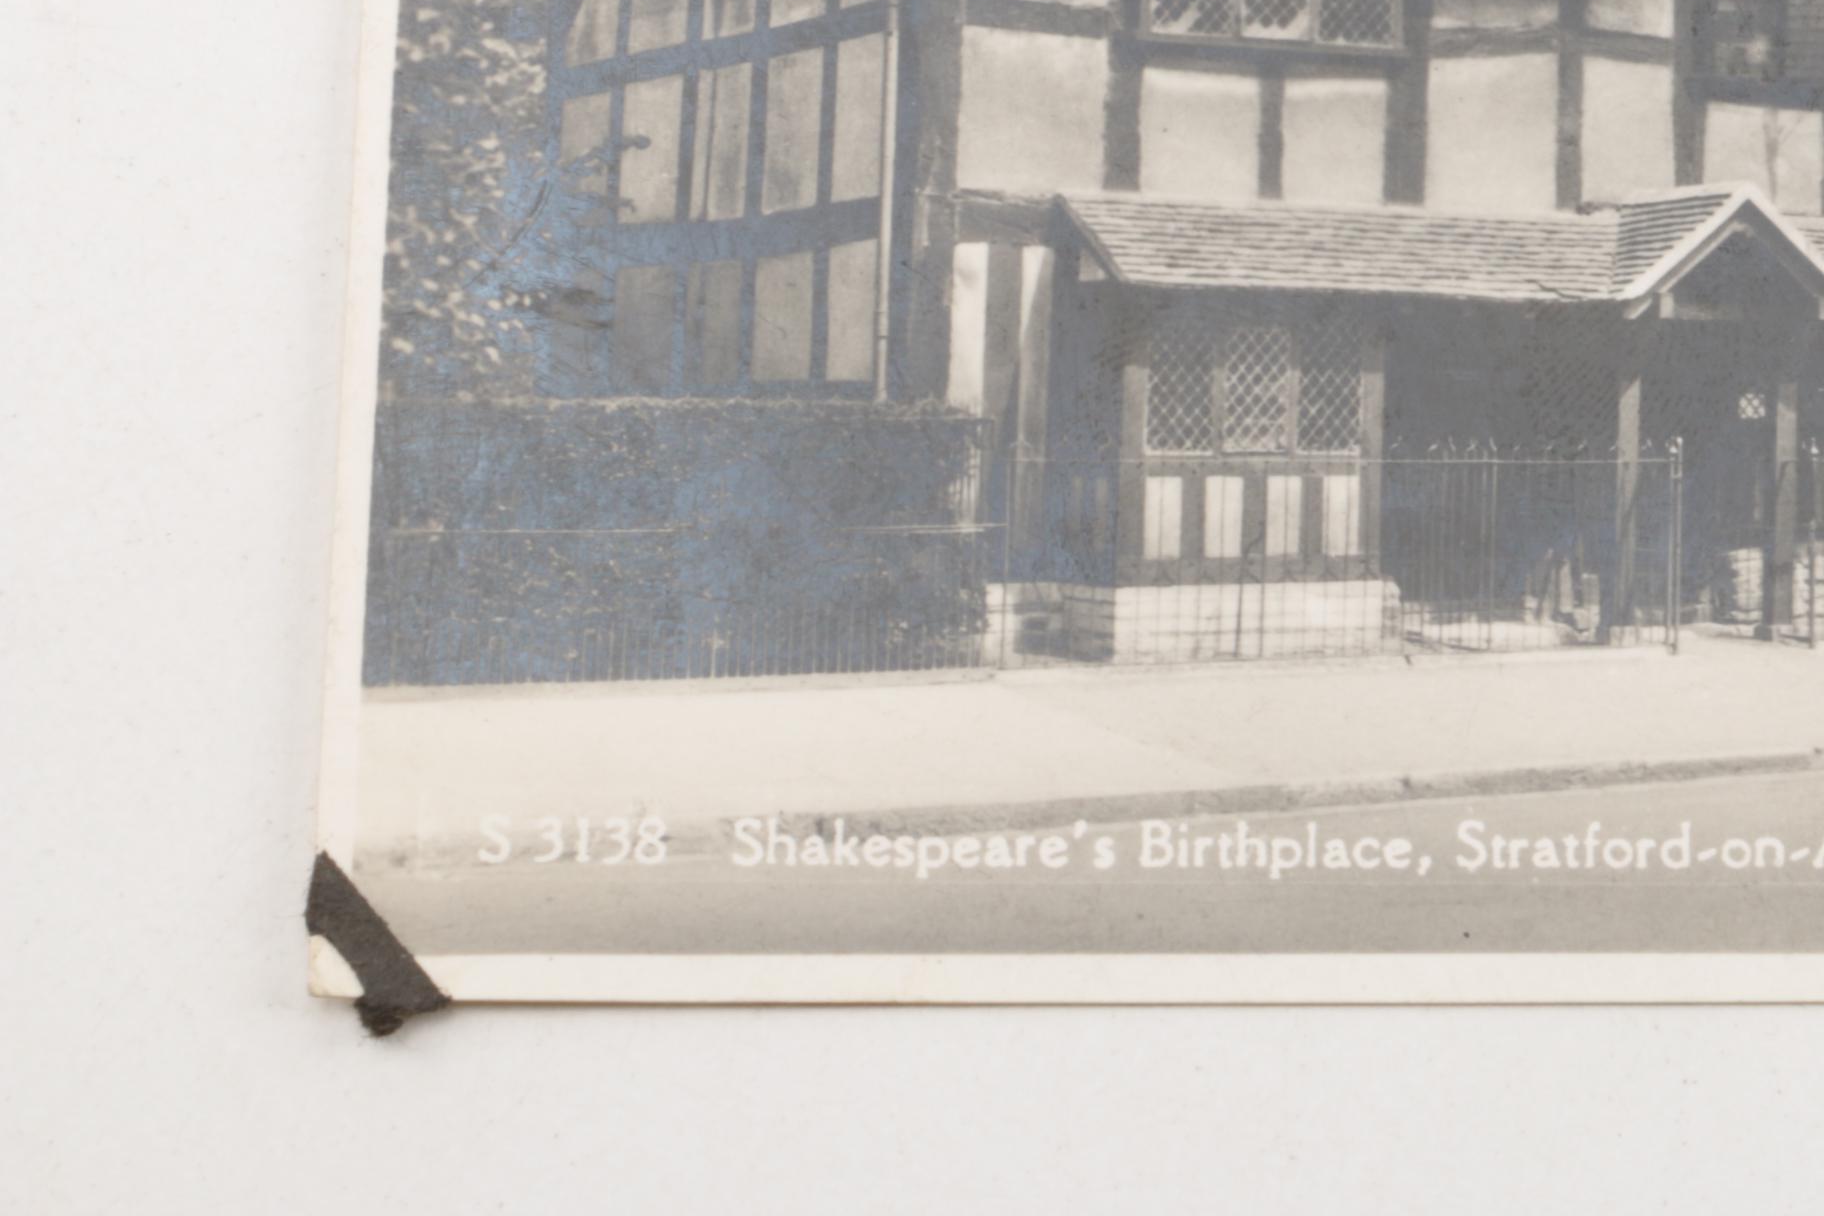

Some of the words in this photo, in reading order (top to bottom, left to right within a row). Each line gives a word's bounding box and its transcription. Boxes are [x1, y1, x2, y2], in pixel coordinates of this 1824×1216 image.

[478, 814, 511, 864] S
[533, 816, 669, 865] 3138
[731, 818, 1116, 877] Shakespeare's
[1138, 821, 1434, 880] Birthplace,
